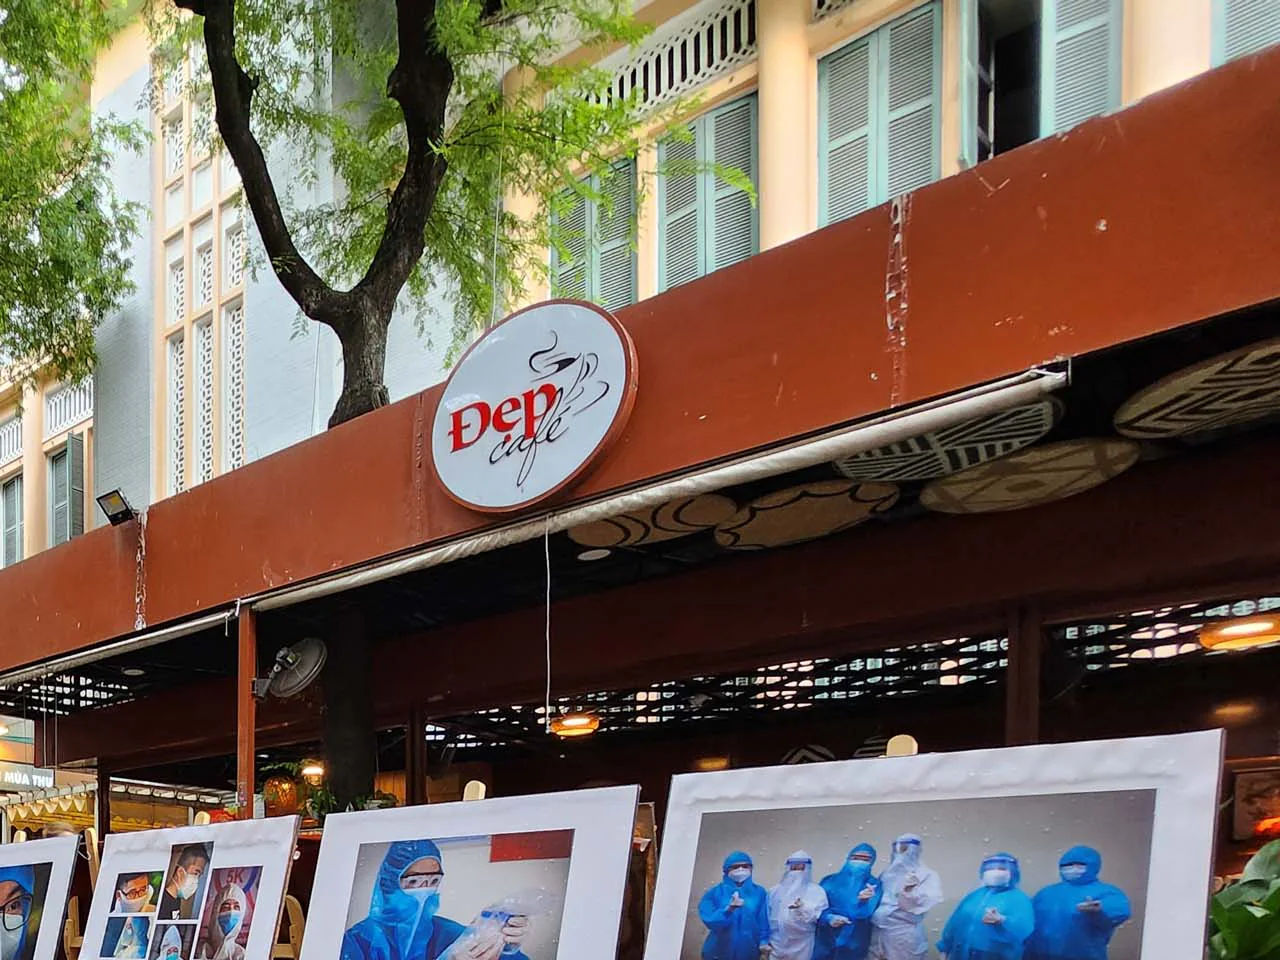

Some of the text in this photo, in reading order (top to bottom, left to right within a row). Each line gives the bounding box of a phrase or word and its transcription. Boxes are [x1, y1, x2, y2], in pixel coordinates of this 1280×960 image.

[448, 383, 558, 454] Đẹp
[4, 768, 30, 786] MÙA
[32, 775, 54, 788] THU
[226, 868, 244, 884] 5K
